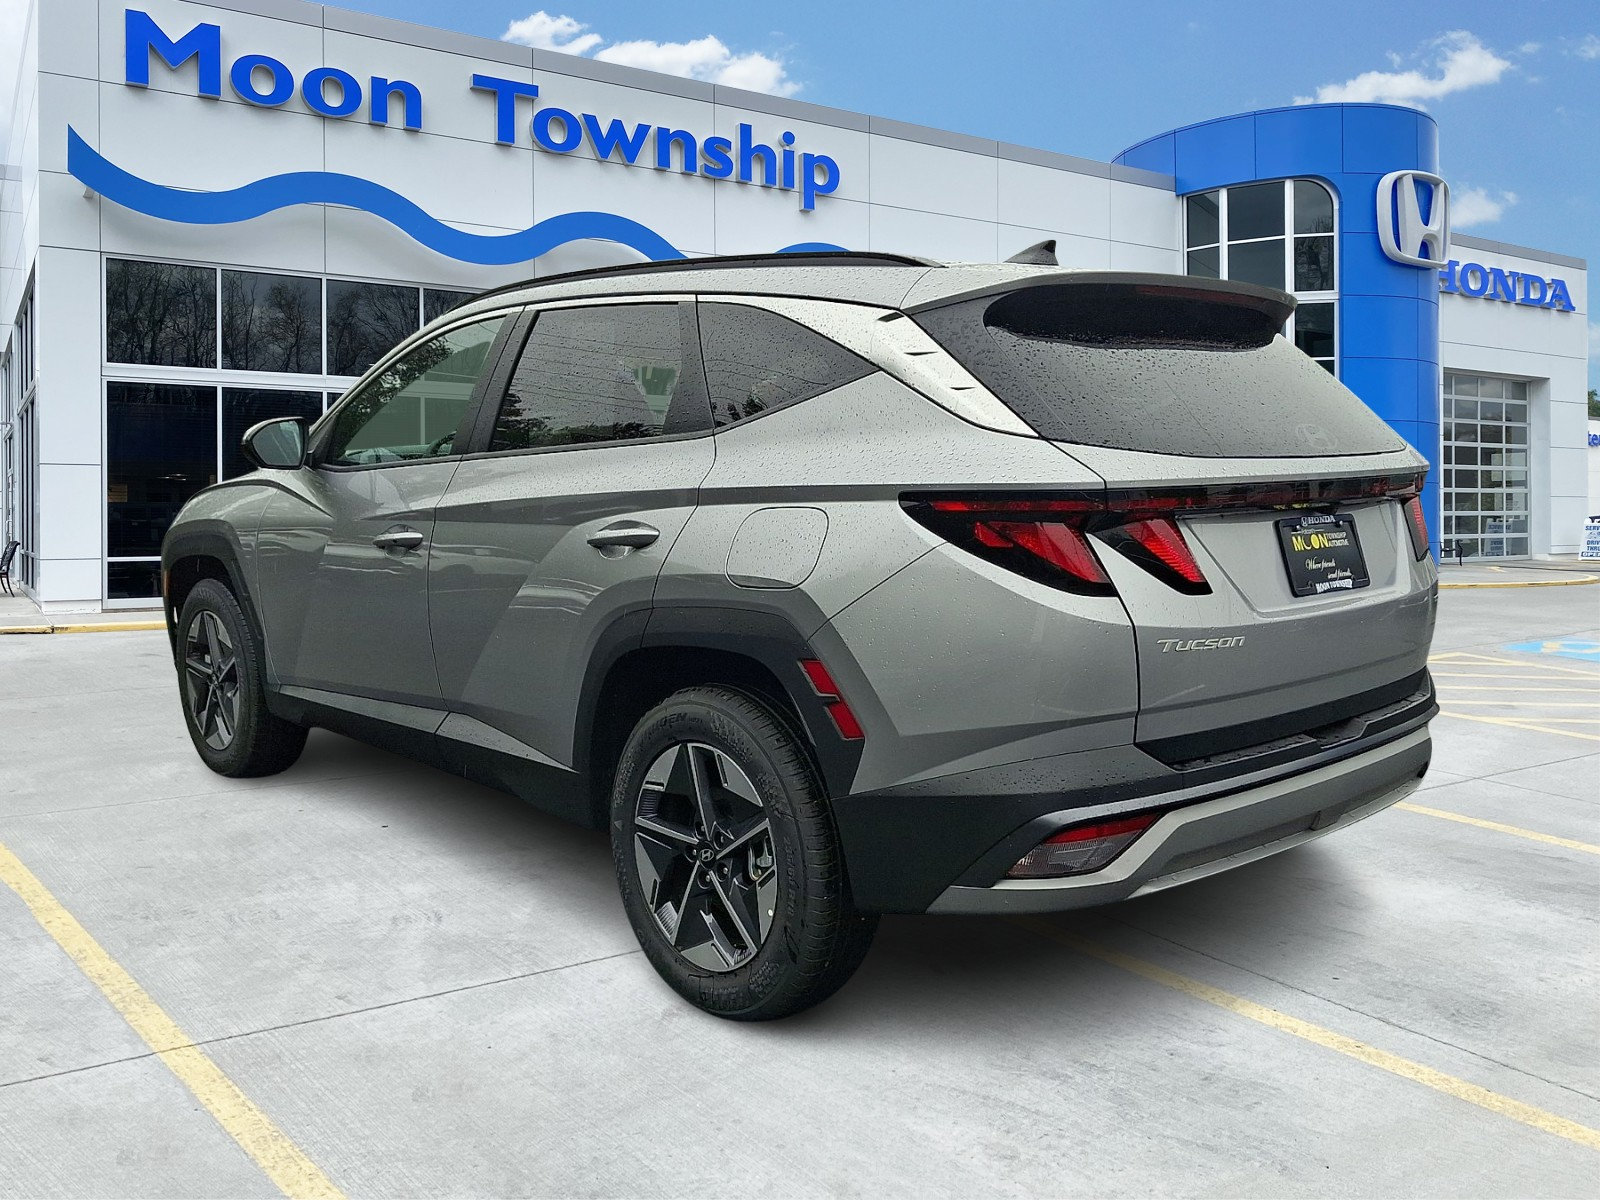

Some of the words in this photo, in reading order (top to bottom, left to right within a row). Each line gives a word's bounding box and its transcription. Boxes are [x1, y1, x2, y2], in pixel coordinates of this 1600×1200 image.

[125, 9, 422, 131] Moon
[470, 73, 840, 212] Township
[1439, 259, 1576, 312] HONDA
[1308, 515, 1336, 524] HONDA
[1292, 533, 1329, 551] MOON
[1305, 557, 1321, 570] Where
[1321, 558, 1336, 572] friends
[1315, 582, 1330, 593] MOON
[1330, 579, 1352, 589] TOWNSHIP
